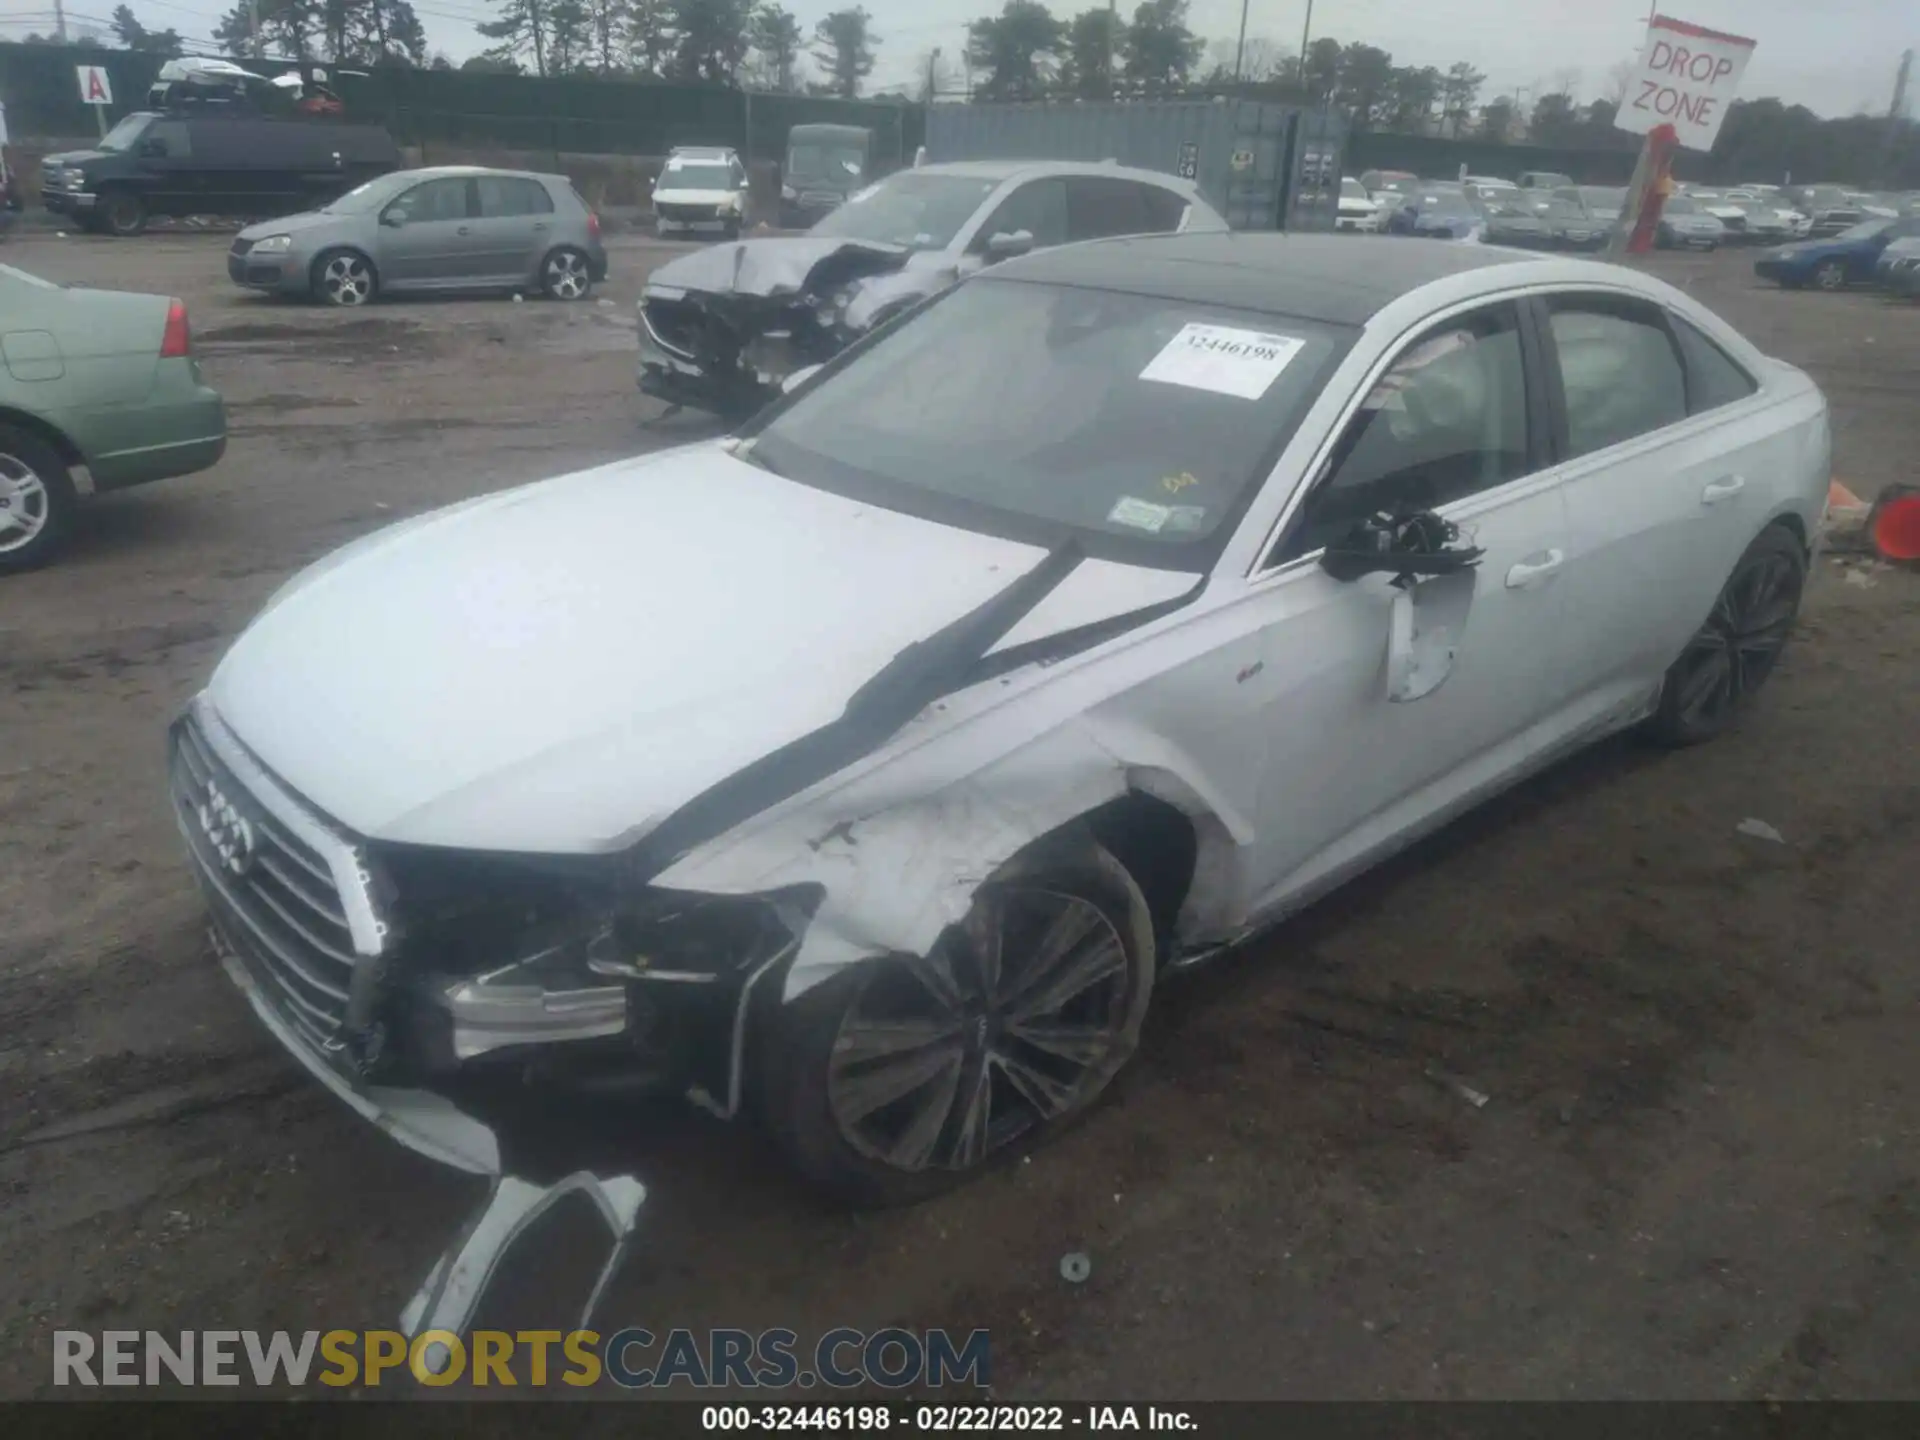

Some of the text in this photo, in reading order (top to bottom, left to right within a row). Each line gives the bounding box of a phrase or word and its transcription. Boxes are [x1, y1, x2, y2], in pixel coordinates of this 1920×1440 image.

[1649, 40, 1732, 84] DROP
[88, 69, 107, 100] A
[1632, 80, 1717, 126] ZONE
